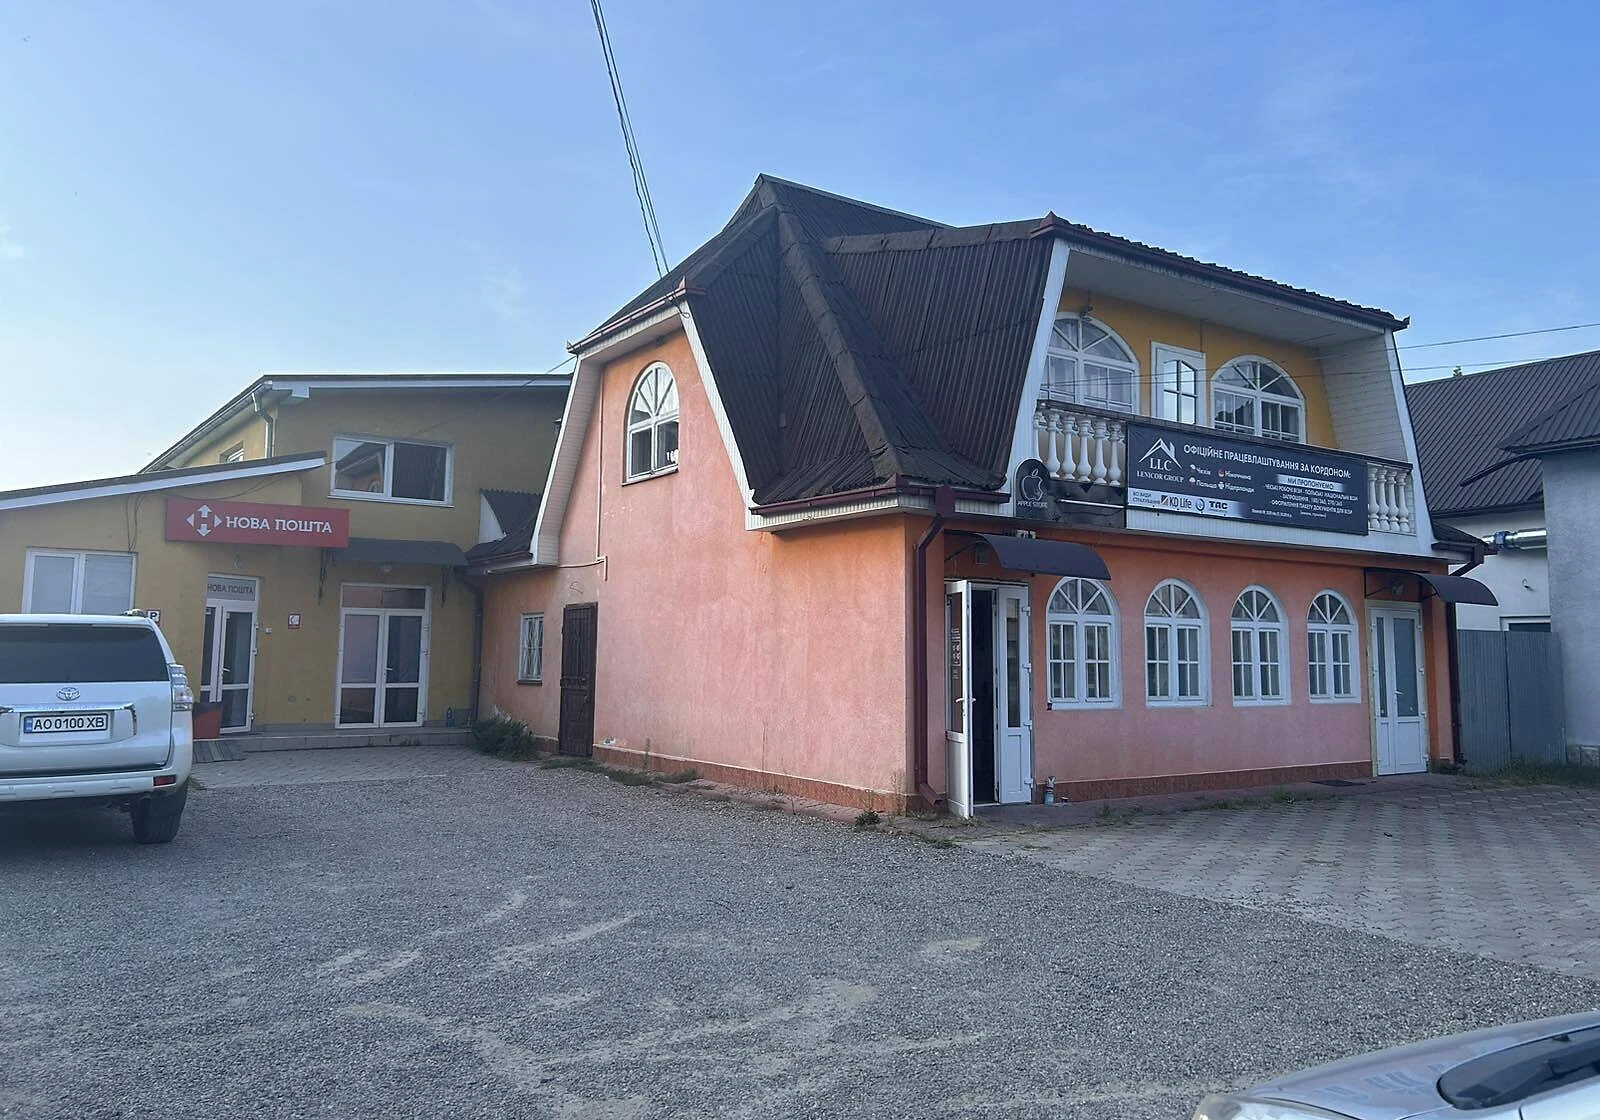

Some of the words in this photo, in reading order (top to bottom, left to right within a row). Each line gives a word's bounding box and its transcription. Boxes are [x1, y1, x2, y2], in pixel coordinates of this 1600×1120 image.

[1149, 457, 1172, 471] LLC
[1183, 444, 1224, 459] ОФІЦІЙНЕ
[1224, 449, 1300, 471] ПРАЦЕВЛАШТУВАННЯ
[1300, 462, 1310, 472] ЗА
[1163, 474, 1184, 483] GROUP
[1179, 497, 1192, 509] Life
[226, 516, 270, 530] НОВА
[275, 519, 332, 533] ПОШТА
[207, 583, 227, 593] НОВА
[228, 585, 254, 595] ПОШТА
[33, 718, 53, 730] AO
[54, 717, 84, 729] 0100
[86, 716, 105, 728] XB
